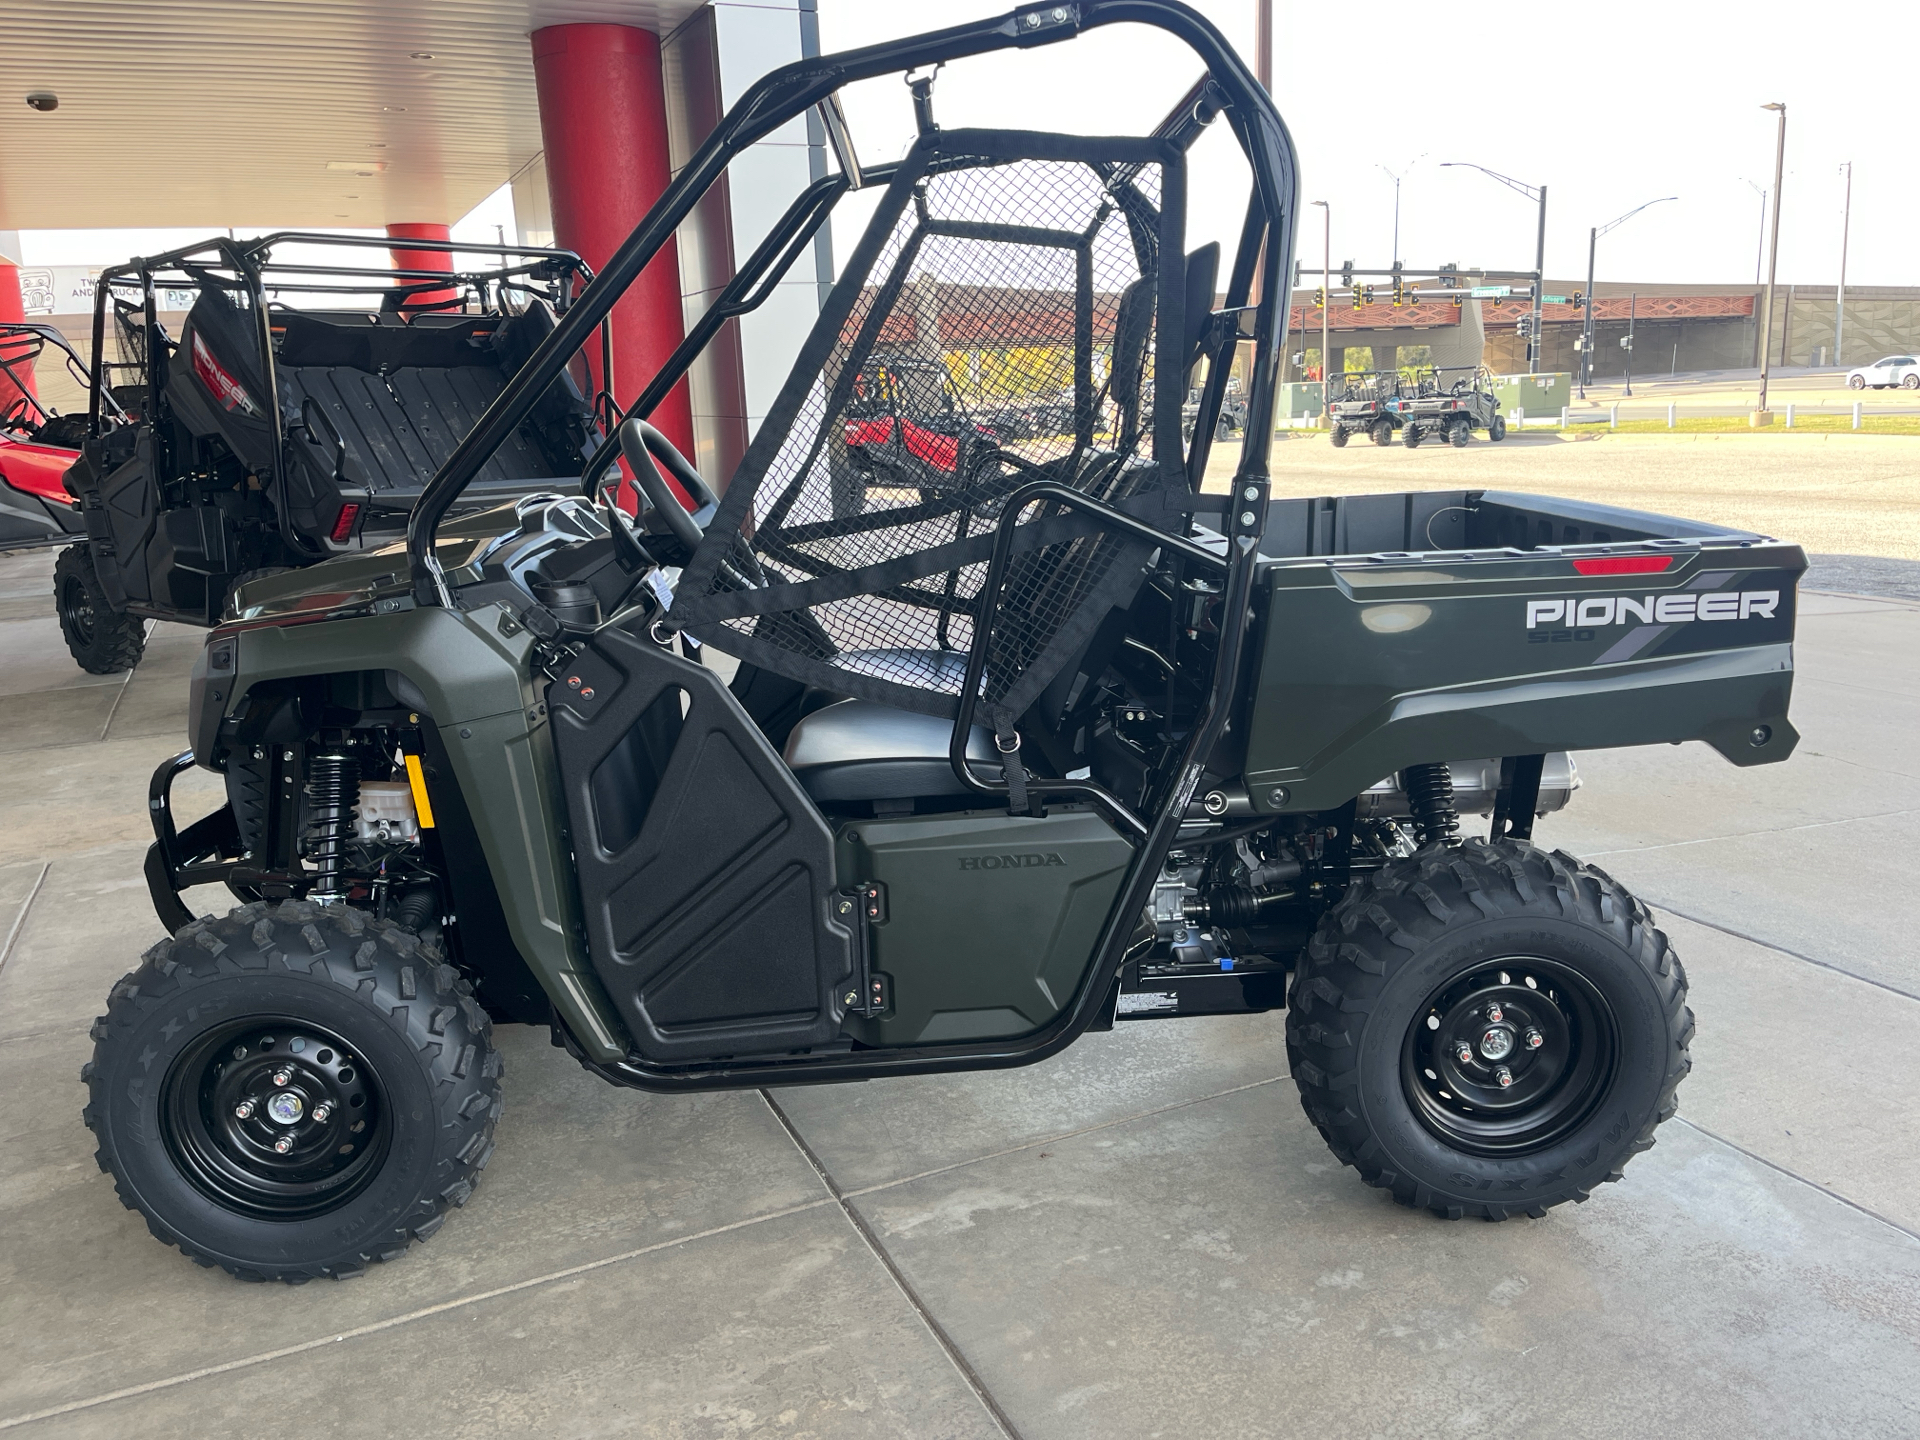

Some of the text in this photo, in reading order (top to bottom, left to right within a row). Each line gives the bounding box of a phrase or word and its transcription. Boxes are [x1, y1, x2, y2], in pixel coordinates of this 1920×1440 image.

[1526, 590, 1780, 629] PIONEER
[1527, 629, 1595, 644] 520
[957, 852, 1068, 871] HONDA
[126, 996, 229, 1146] MAXXIS
[1448, 1110, 1632, 1192] MAXXIS
